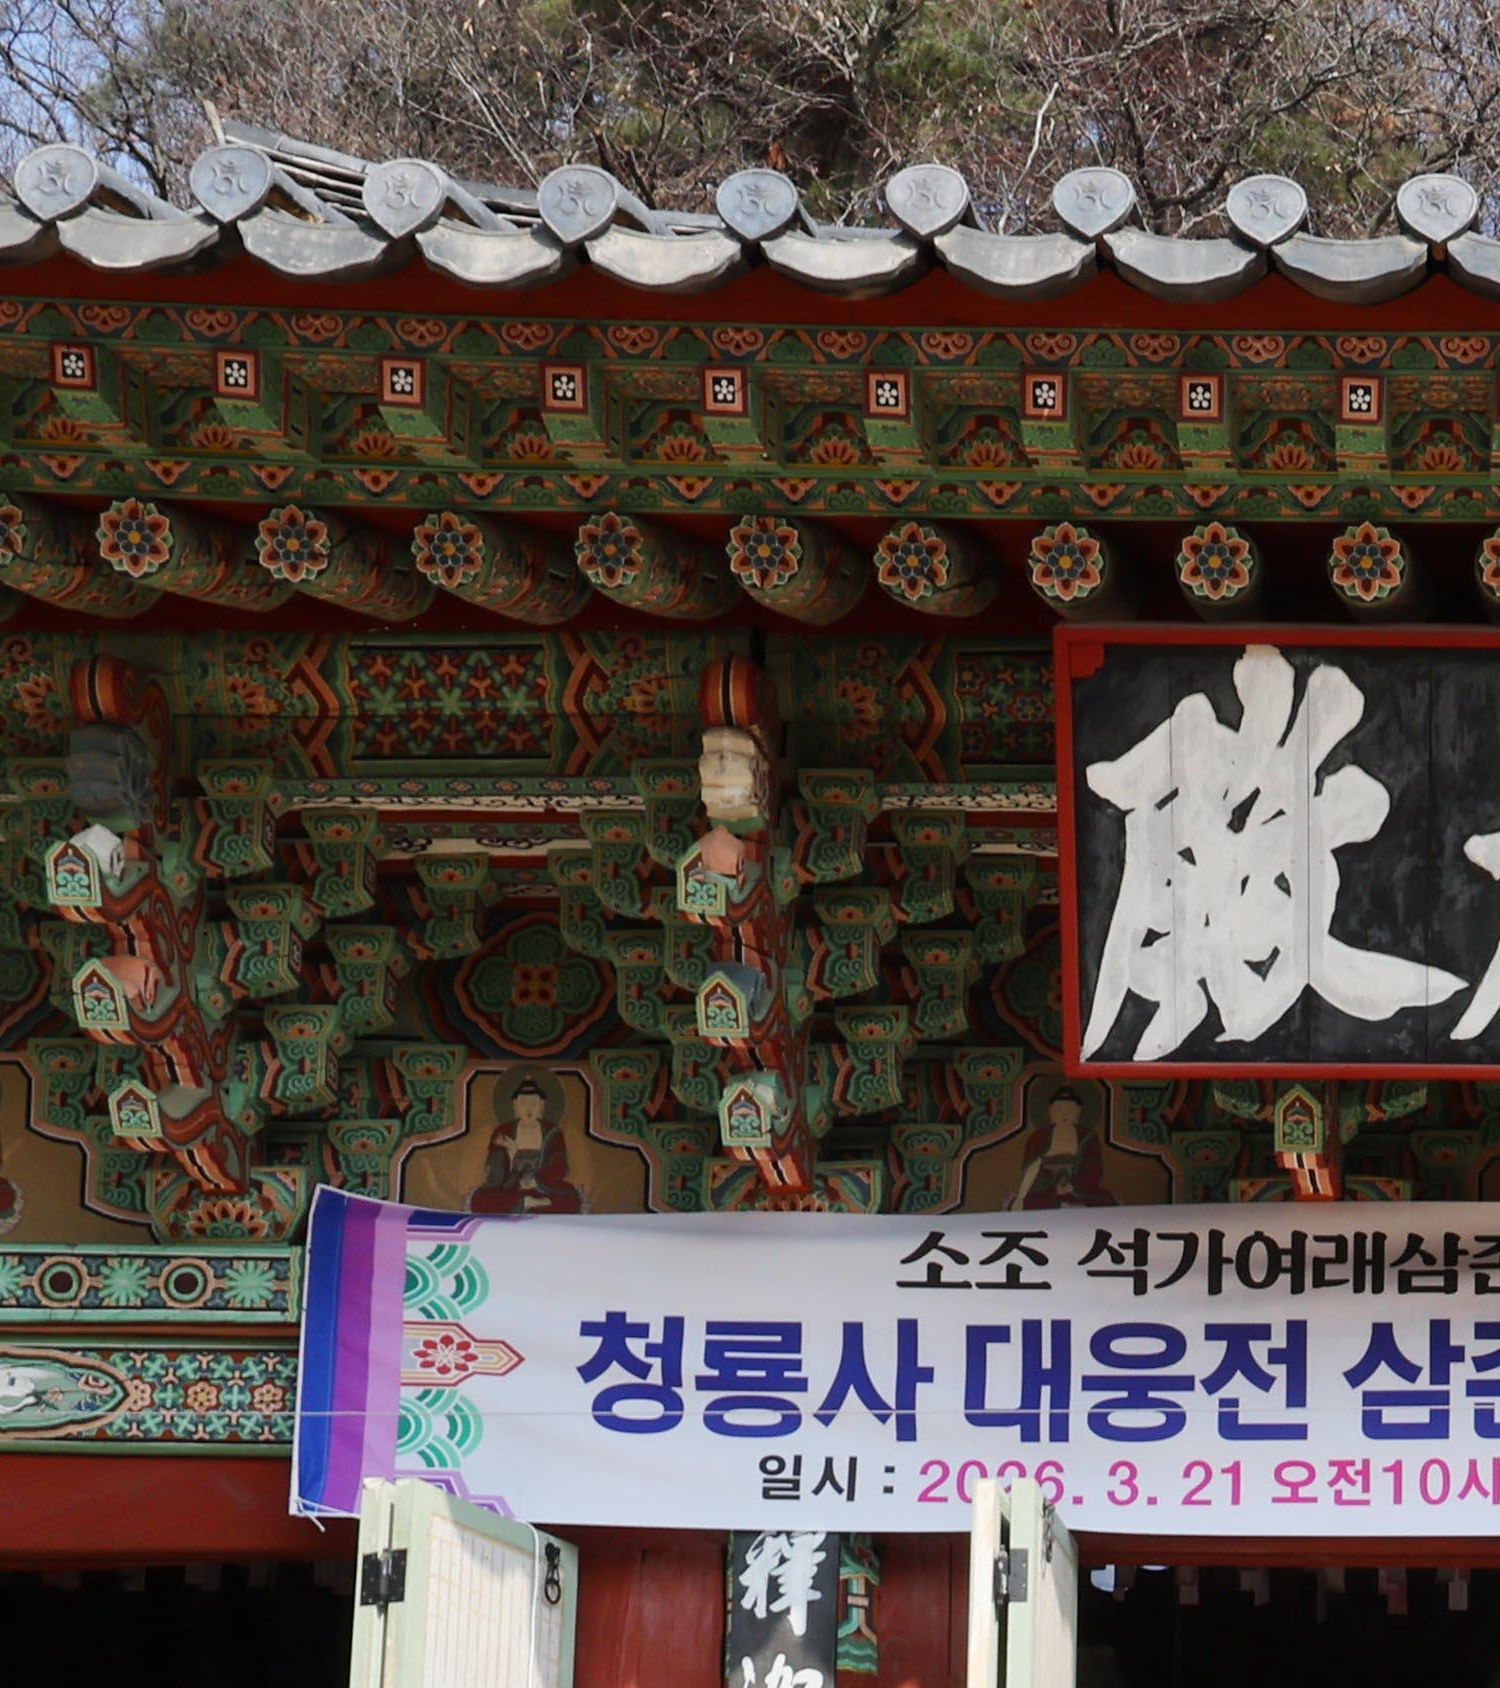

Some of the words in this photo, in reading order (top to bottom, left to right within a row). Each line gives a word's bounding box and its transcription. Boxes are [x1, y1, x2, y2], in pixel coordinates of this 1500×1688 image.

[896, 1230, 1052, 1291] 소조
[577, 1310, 935, 1442] 청룡사
[962, 1318, 1309, 1443] 대웅전
[758, 1454, 858, 1503] 일시
[1106, 1460, 1159, 1506] 3.
[1181, 1460, 1243, 1507] 21
